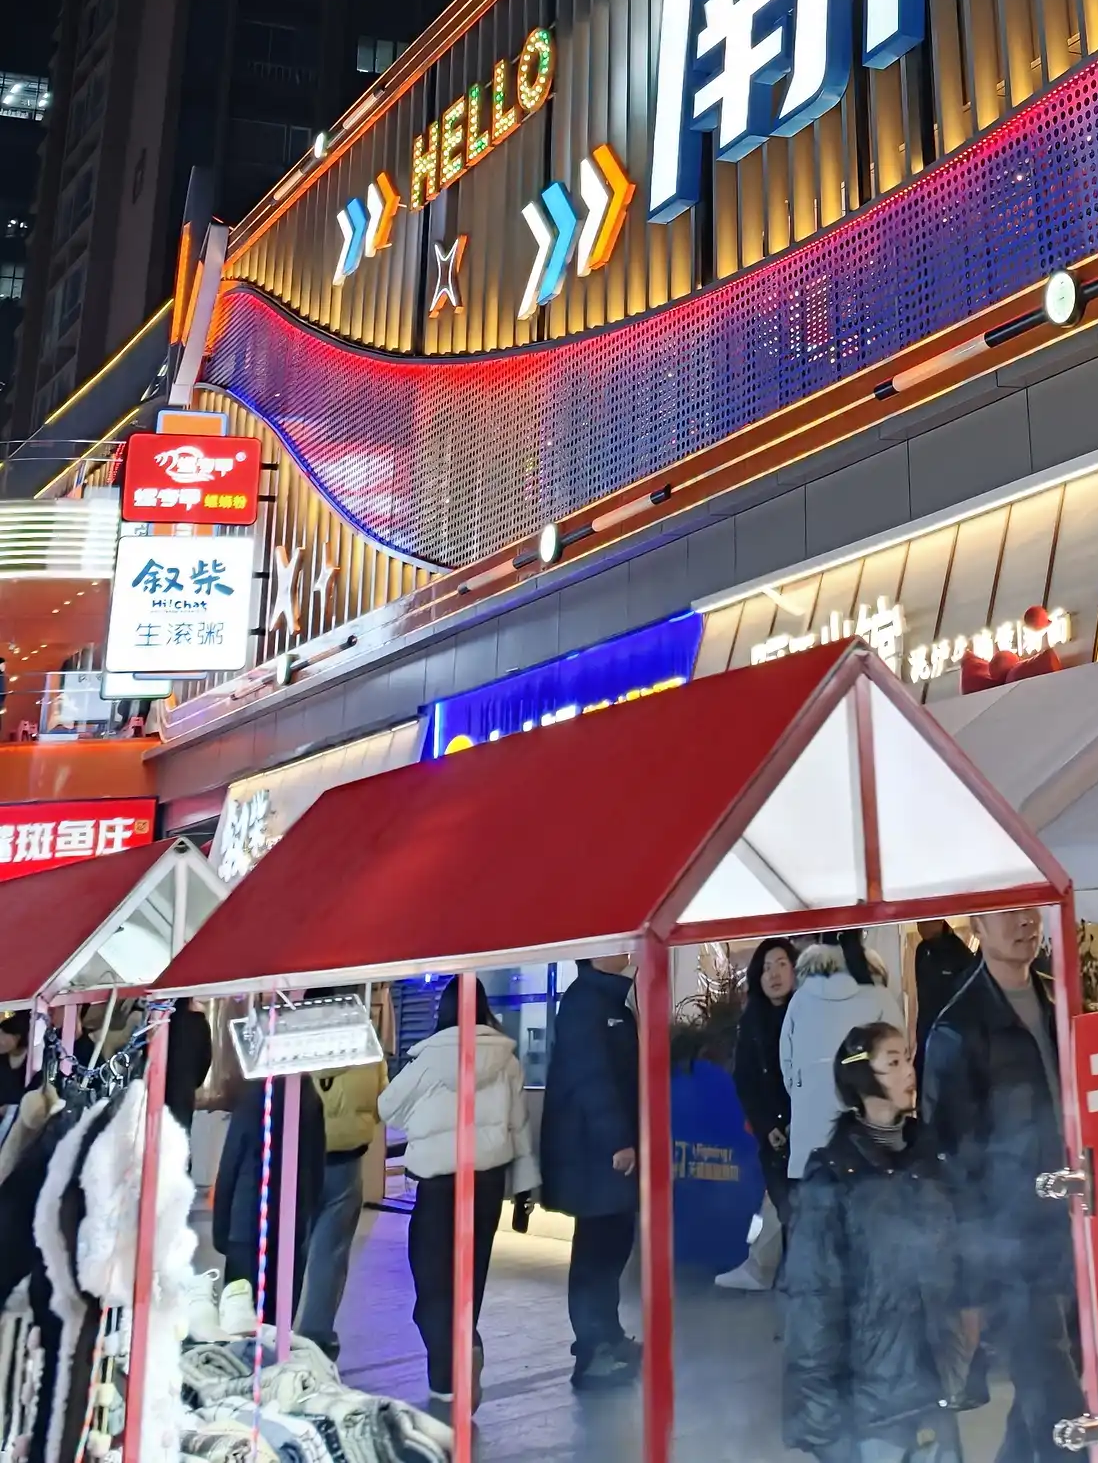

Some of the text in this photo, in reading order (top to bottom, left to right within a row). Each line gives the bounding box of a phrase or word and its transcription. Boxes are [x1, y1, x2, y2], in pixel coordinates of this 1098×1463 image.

[410, 27, 555, 213] HELLO
[131, 558, 235, 596] 叙柴
[134, 621, 224, 647] 生滚粥
